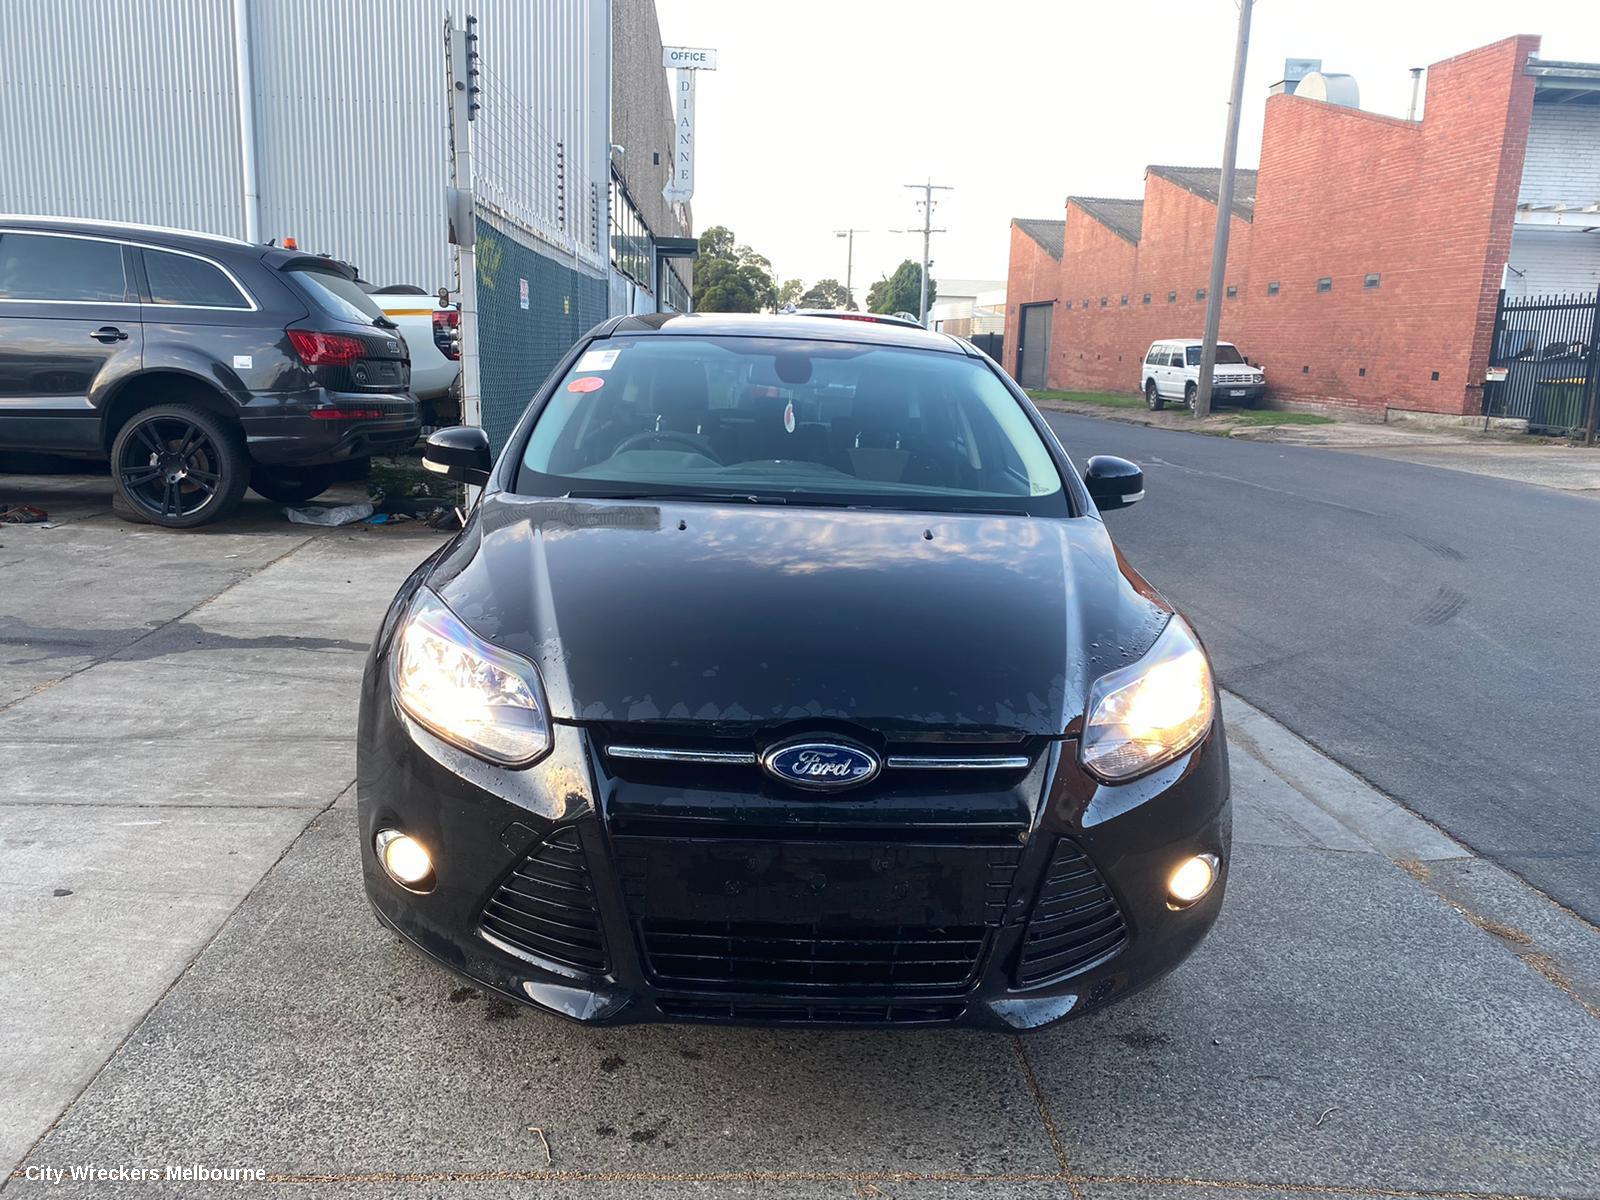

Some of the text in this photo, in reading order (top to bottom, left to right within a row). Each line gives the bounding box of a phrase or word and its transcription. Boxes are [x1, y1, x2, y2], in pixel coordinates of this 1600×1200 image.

[670, 51, 706, 61] OFFICE
[680, 81, 690, 180] DIANNE
[791, 750, 852, 776] Ford
